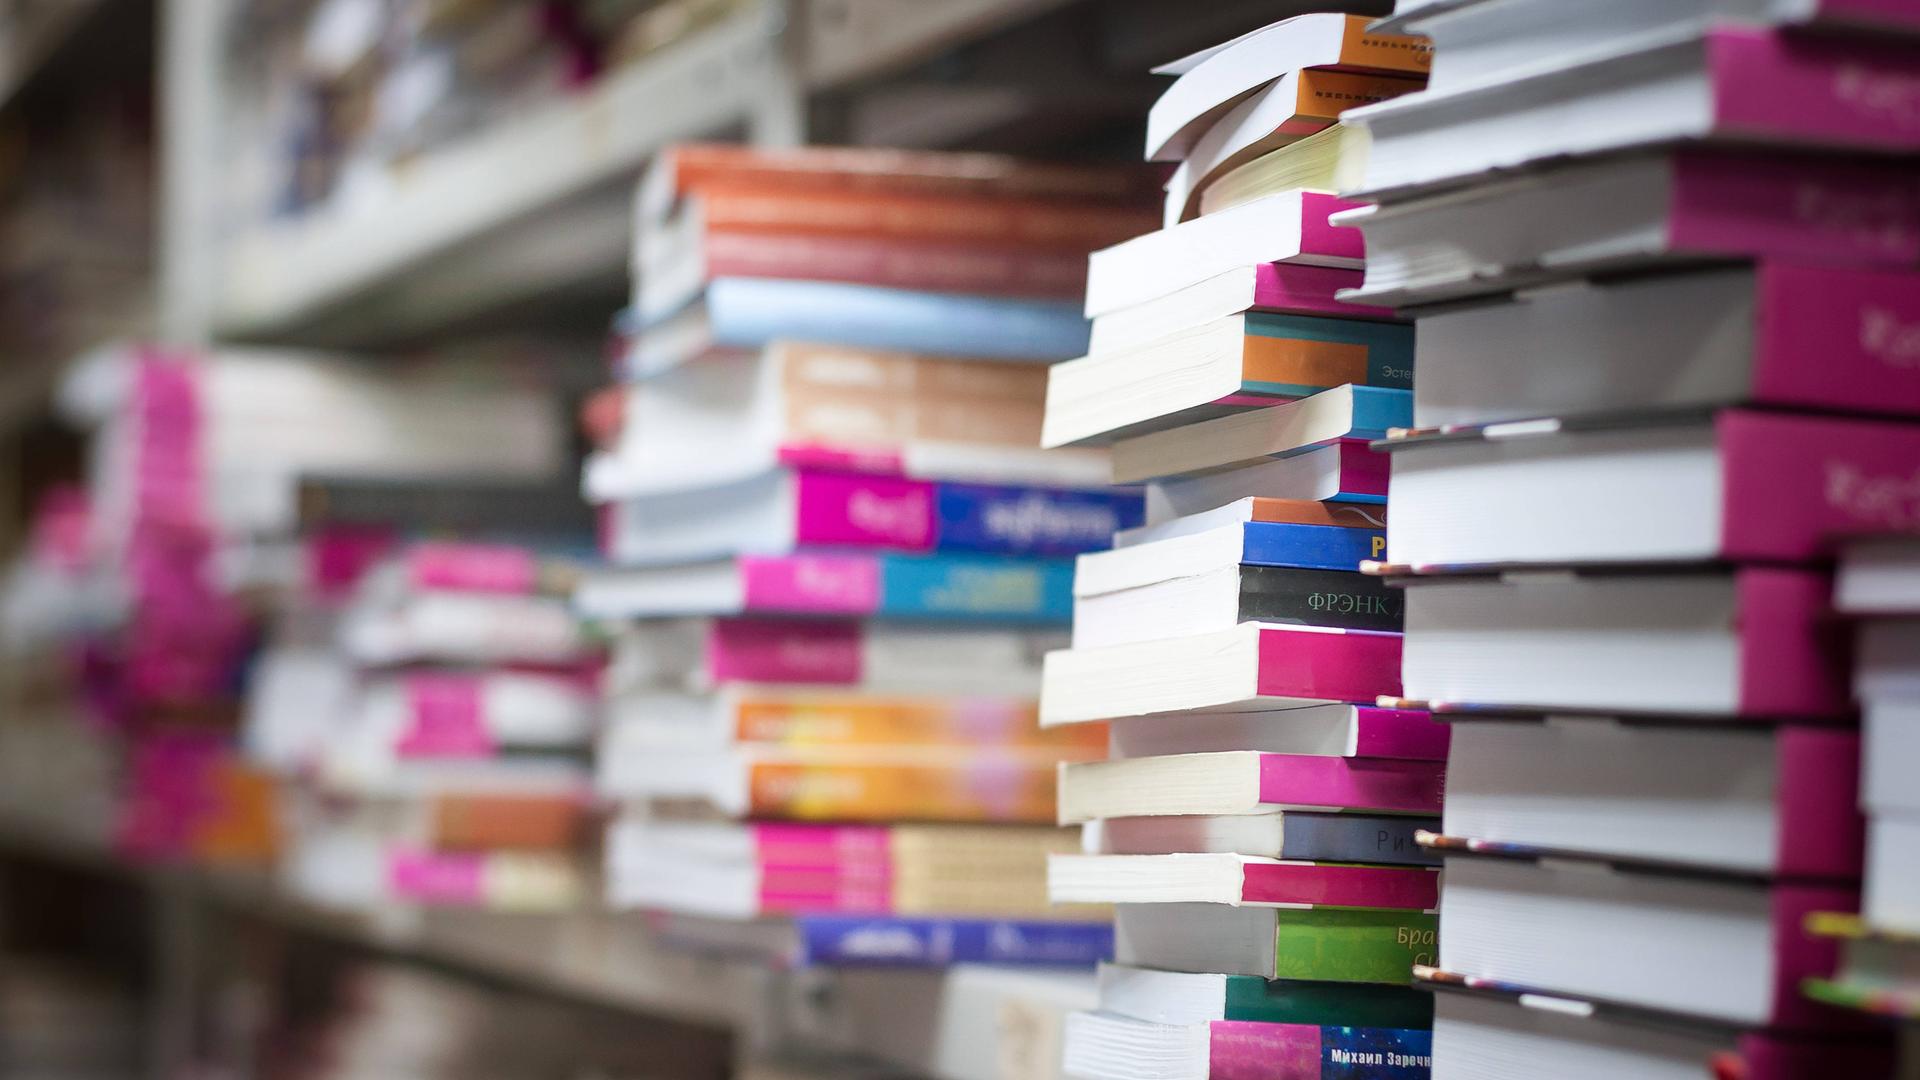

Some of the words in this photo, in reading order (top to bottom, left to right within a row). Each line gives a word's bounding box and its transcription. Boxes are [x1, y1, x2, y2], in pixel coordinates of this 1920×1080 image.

[1308, 592, 1389, 614] ФРЭНК
[1397, 926, 1435, 949] Бра
[1331, 1049, 1383, 1065] Михаил
